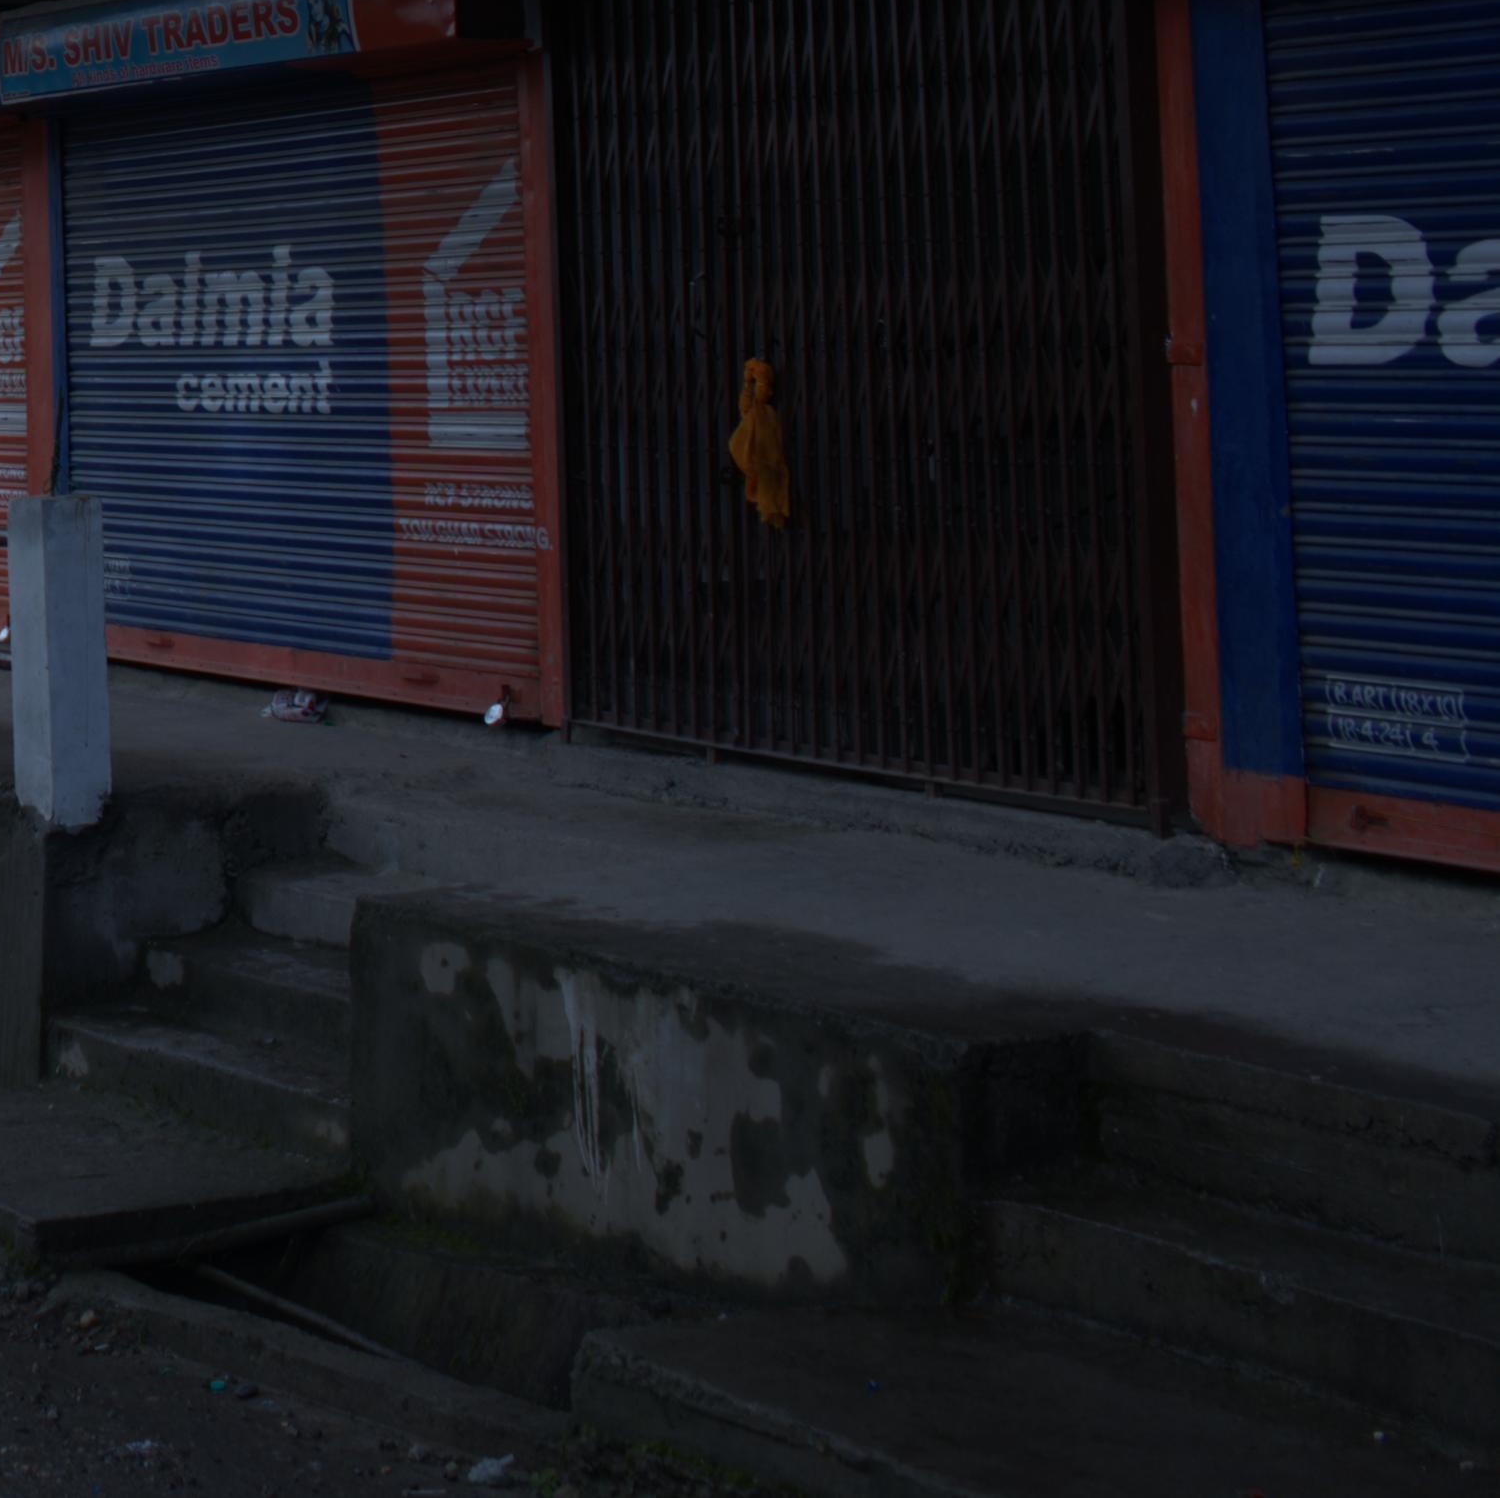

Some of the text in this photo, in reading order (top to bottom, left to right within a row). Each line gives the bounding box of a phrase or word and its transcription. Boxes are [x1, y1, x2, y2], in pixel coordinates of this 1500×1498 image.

[2, 35, 57, 77] M/S.
[62, 19, 133, 67] SHIV
[90, 244, 336, 347] Dalmia
[175, 357, 332, 415] cement
